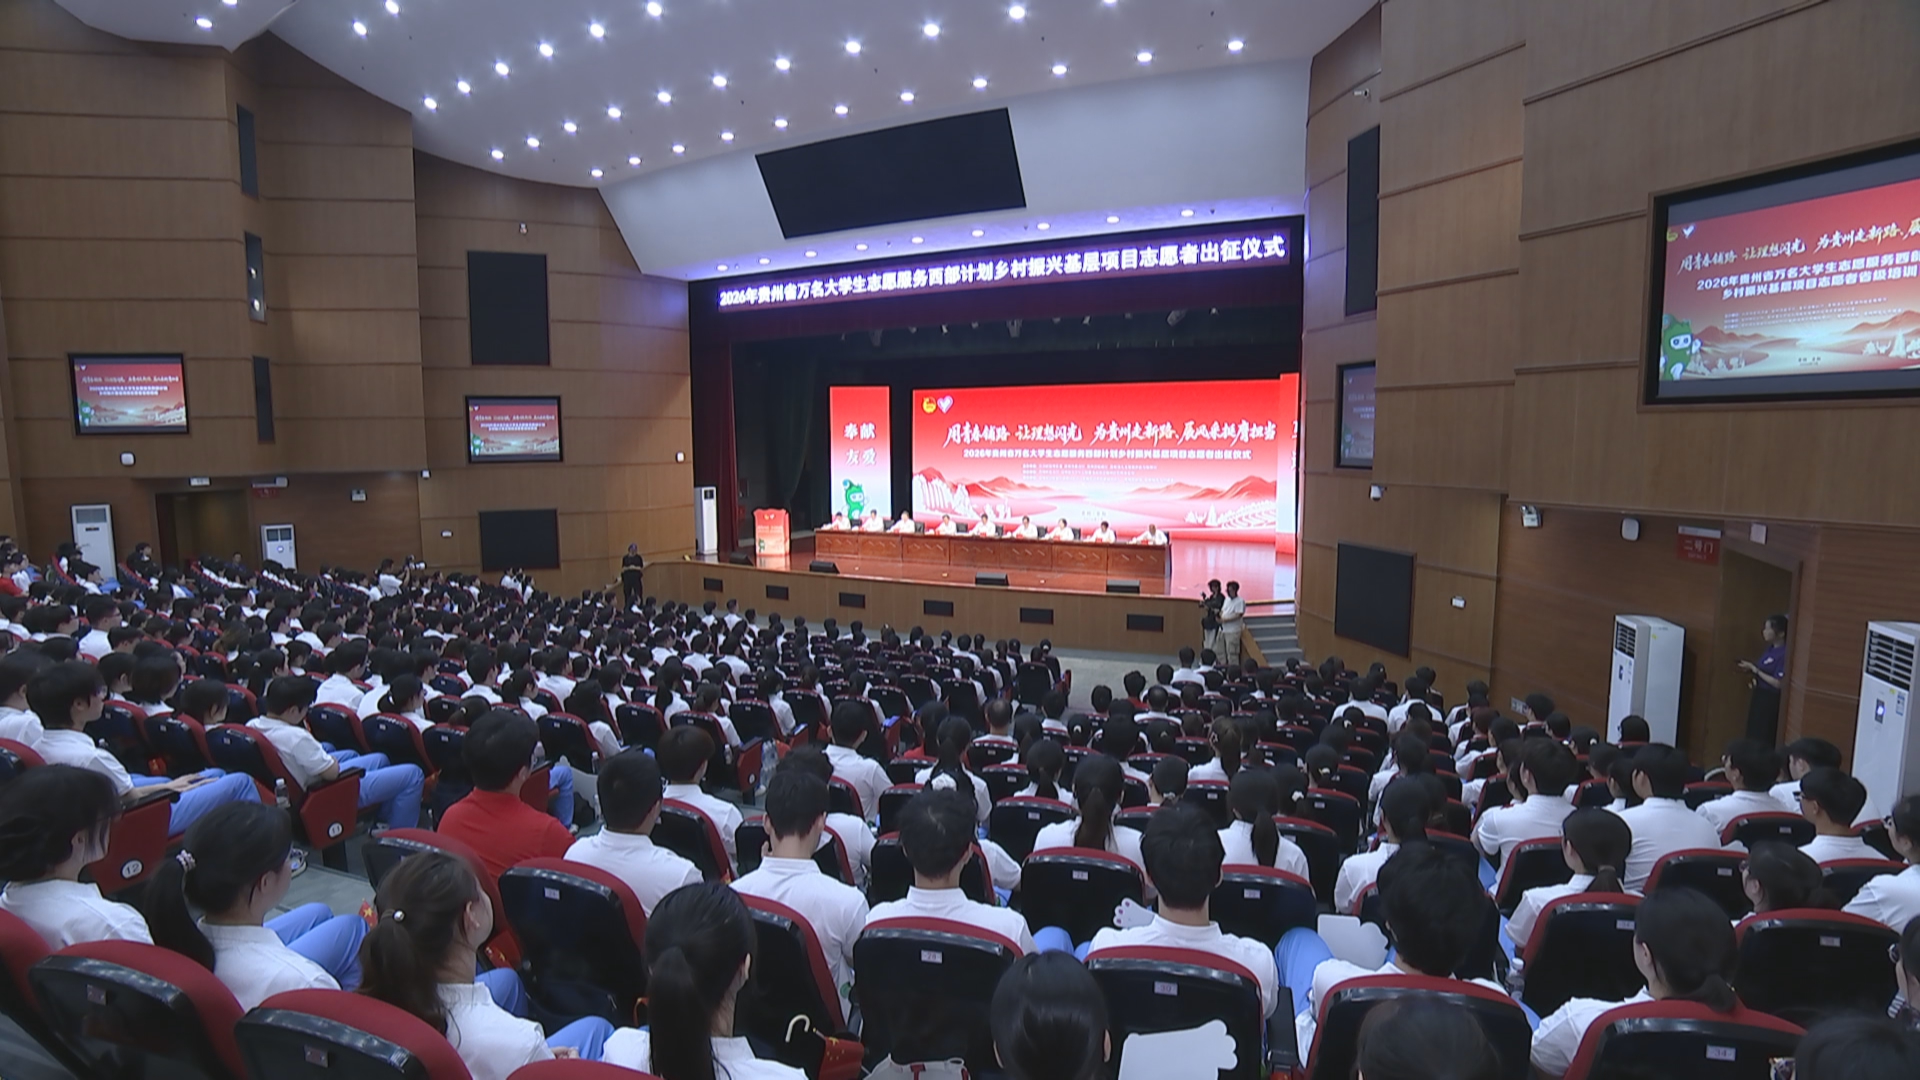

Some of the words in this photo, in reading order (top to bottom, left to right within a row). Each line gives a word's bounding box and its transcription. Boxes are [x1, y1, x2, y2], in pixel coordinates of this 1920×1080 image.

[1742, 237, 1806, 260] 让理想闪光
[718, 234, 1286, 306] 2026年贵州省万名大学生志愿服务西部计划乡村振兴基层项目志愿者出征仪式
[843, 421, 877, 440] 奉献
[943, 421, 1010, 448] 用青春铺路
[1015, 422, 1082, 445] 让理想闪光
[846, 447, 877, 465] 友爱
